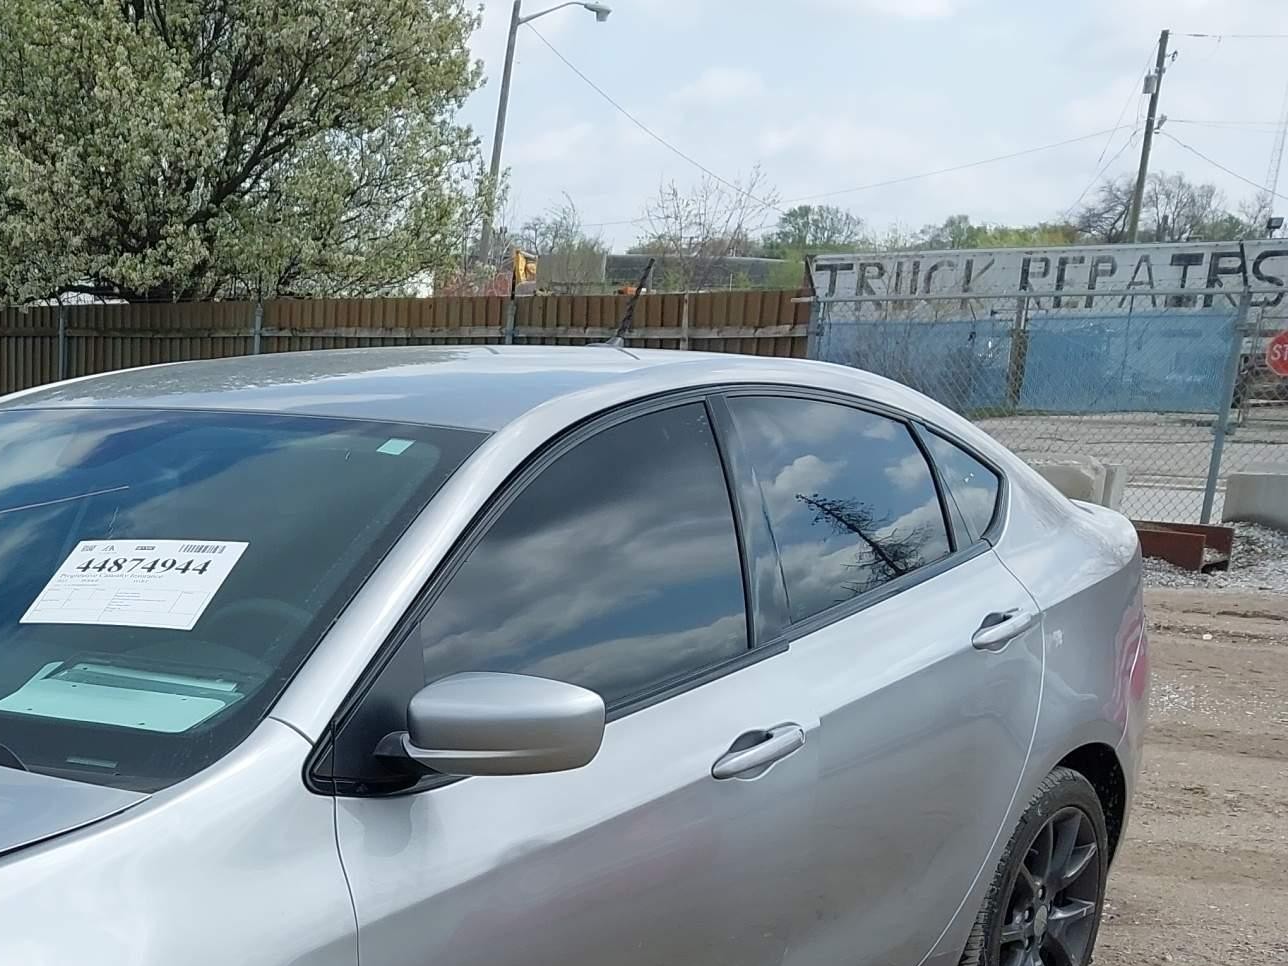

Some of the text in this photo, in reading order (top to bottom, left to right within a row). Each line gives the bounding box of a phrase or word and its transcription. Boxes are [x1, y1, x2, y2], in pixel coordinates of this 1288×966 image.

[814, 249, 1288, 311] TRUCK REPAIRS
[76, 556, 213, 575] 44874944
